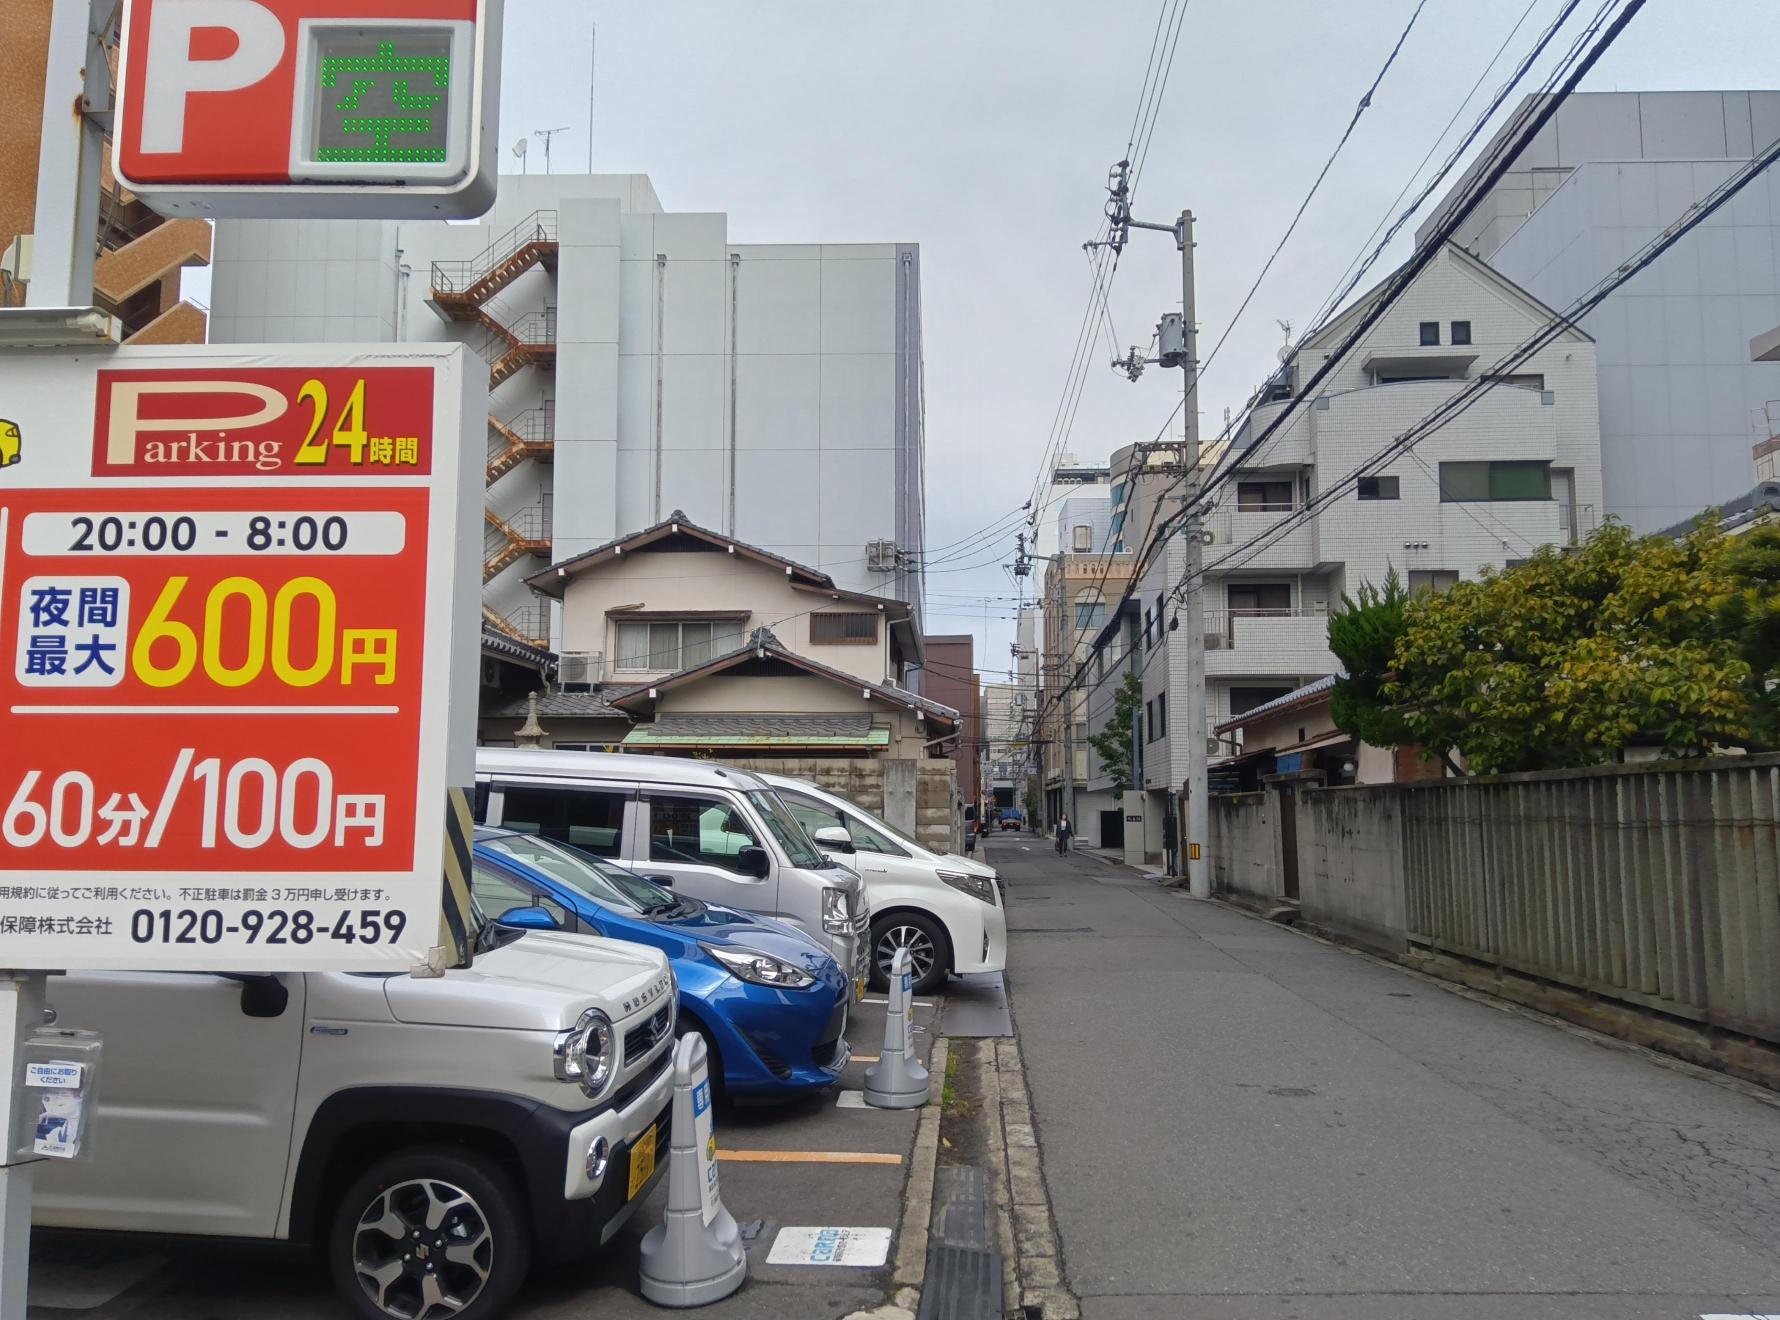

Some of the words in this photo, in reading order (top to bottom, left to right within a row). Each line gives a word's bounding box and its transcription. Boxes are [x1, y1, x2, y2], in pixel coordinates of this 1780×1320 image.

[140, 0, 286, 154] P
[318, 41, 450, 163] 空
[107, 380, 288, 470] Parking
[293, 379, 419, 465] 24時間
[68, 515, 197, 552] 20:00
[246, 515, 348, 552] 8:00
[29, 585, 120, 629] 夜間
[24, 634, 117, 677] 最大
[130, 908, 408, 945] 0120-928-459
